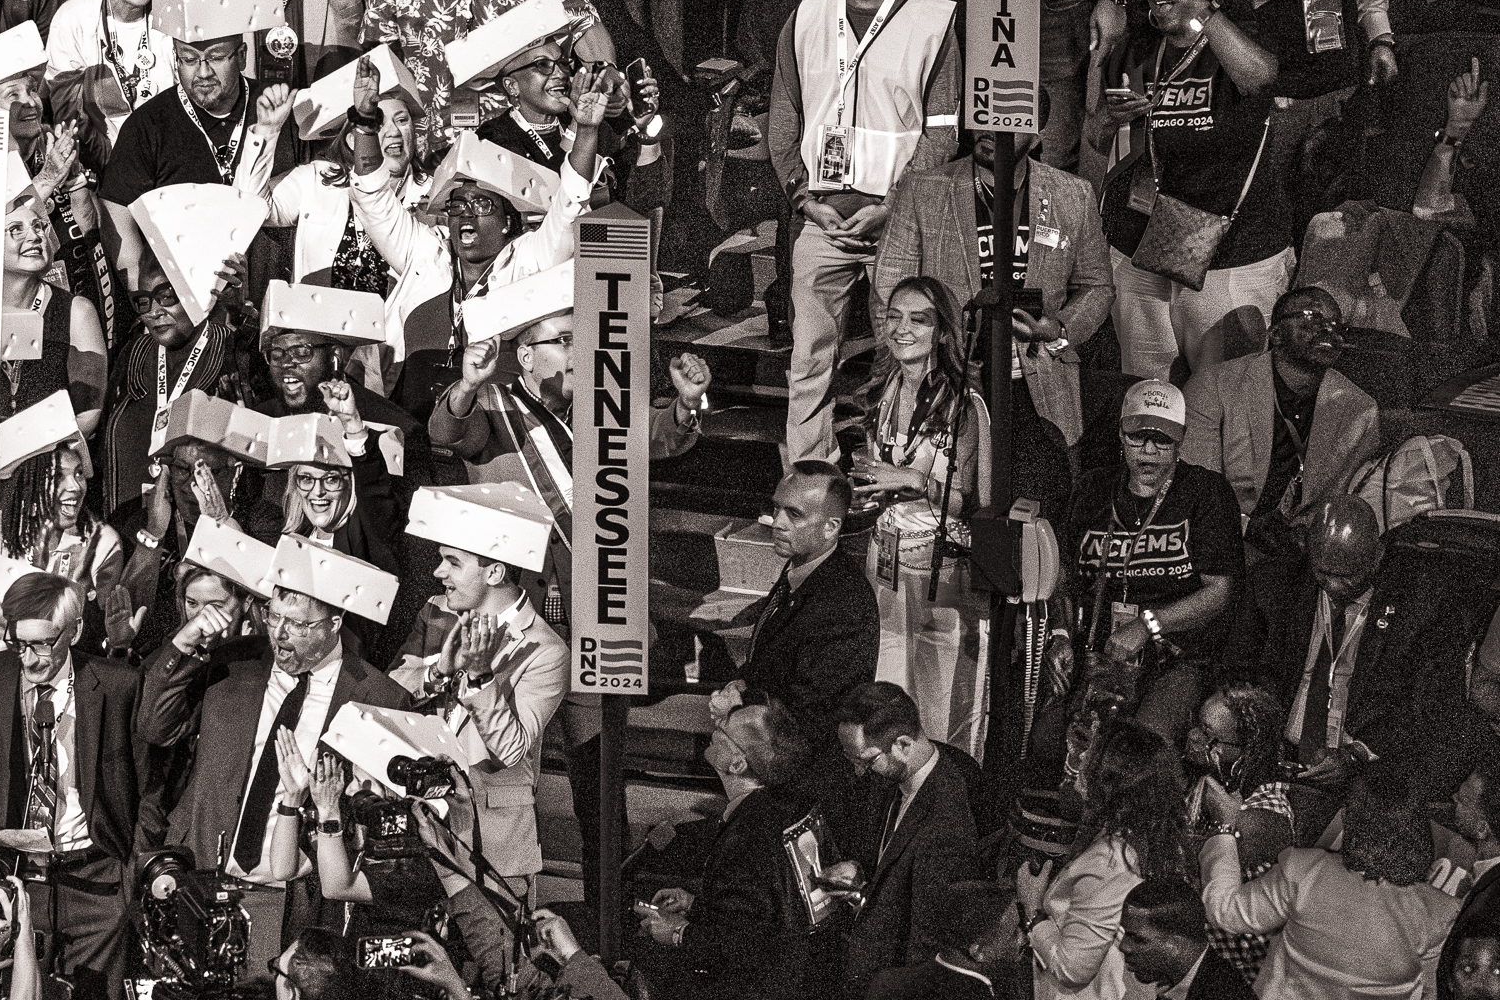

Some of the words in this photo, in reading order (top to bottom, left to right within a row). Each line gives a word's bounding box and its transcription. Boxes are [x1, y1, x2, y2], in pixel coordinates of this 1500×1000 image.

[973, 77, 989, 125] DNC
[992, 116, 1034, 128] 2024
[1187, 115, 1214, 127] 2024
[594, 272, 632, 625] TENNESSEE
[1086, 531, 1183, 558] NCDEMS
[1115, 567, 1165, 579] CHICAGO
[1169, 562, 1193, 576] 2024
[579, 637, 598, 687] DNC
[600, 678, 642, 689] 2024
